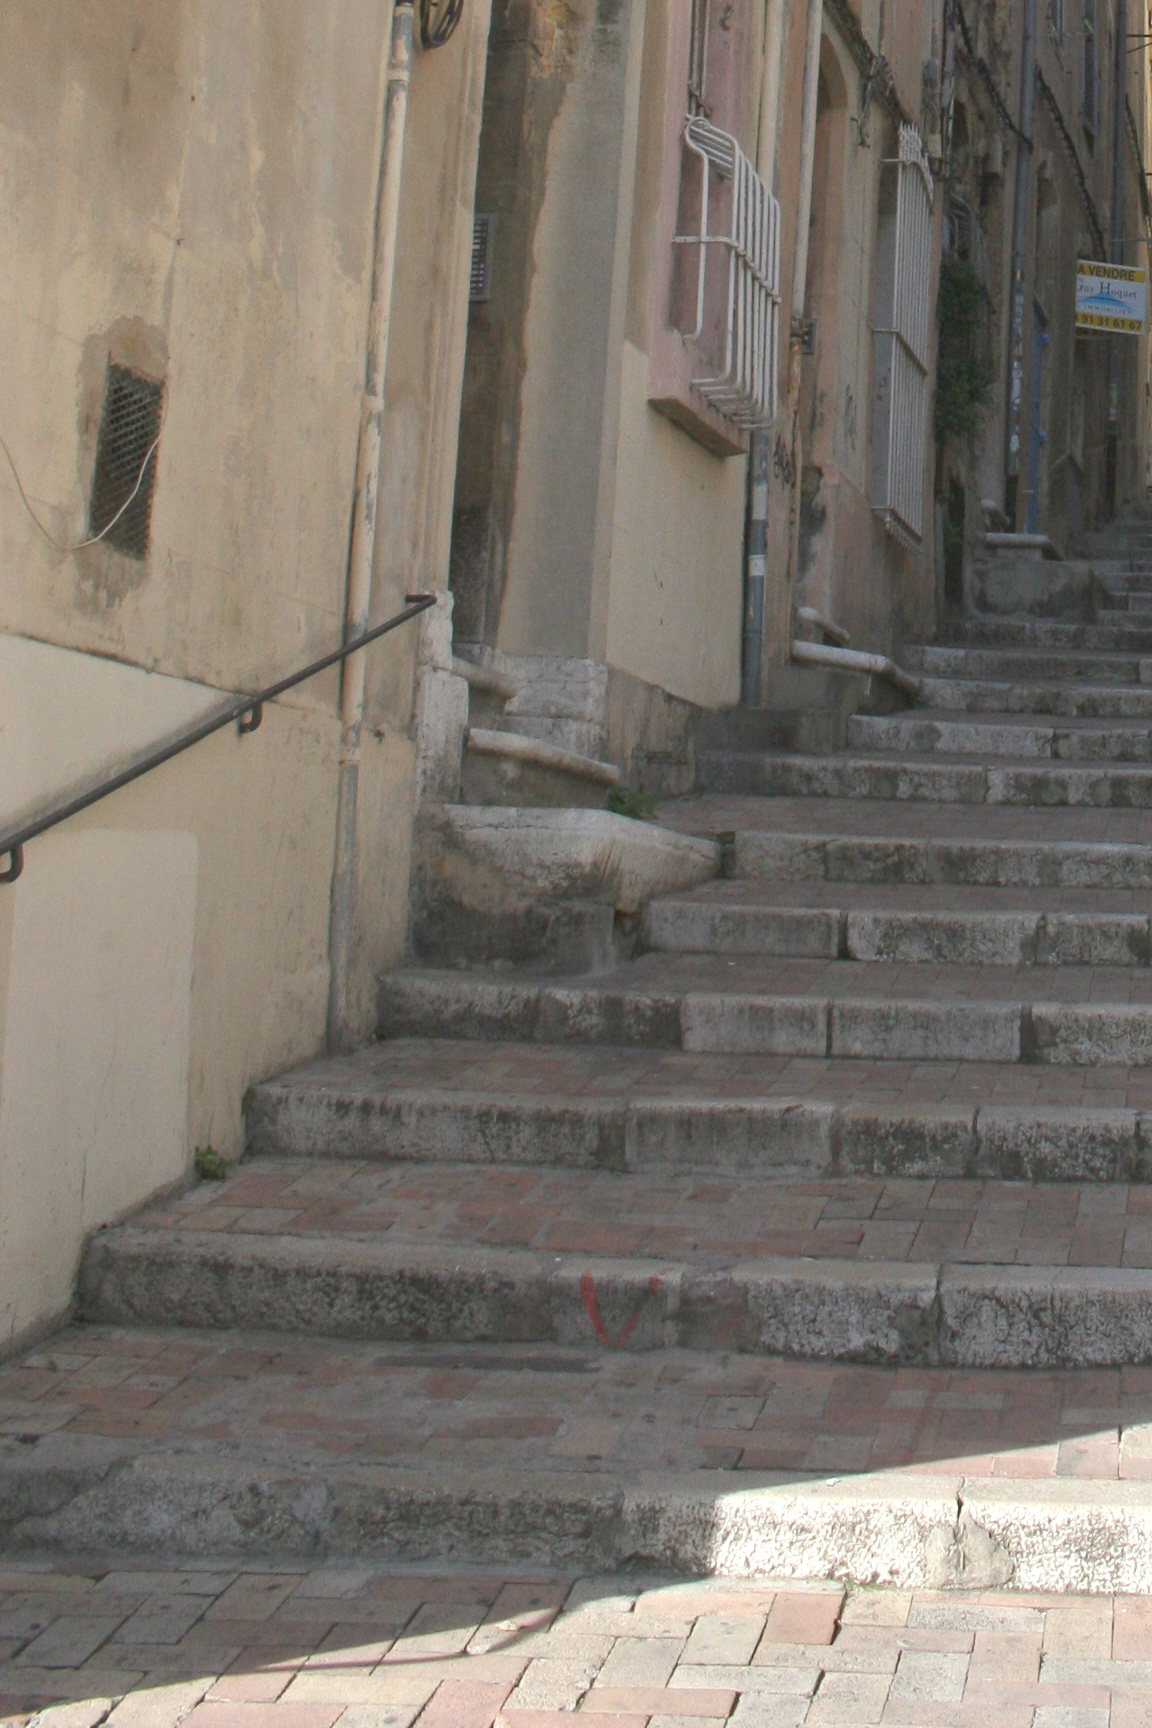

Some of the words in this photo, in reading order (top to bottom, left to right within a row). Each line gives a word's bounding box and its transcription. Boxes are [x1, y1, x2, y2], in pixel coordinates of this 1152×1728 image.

[1077, 263, 1085, 275] A
[1088, 265, 1135, 281] VENDRE
[1100, 281, 1137, 299] Hoquet
[1113, 318, 1125, 328] 61
[1129, 320, 1142, 330] 67
